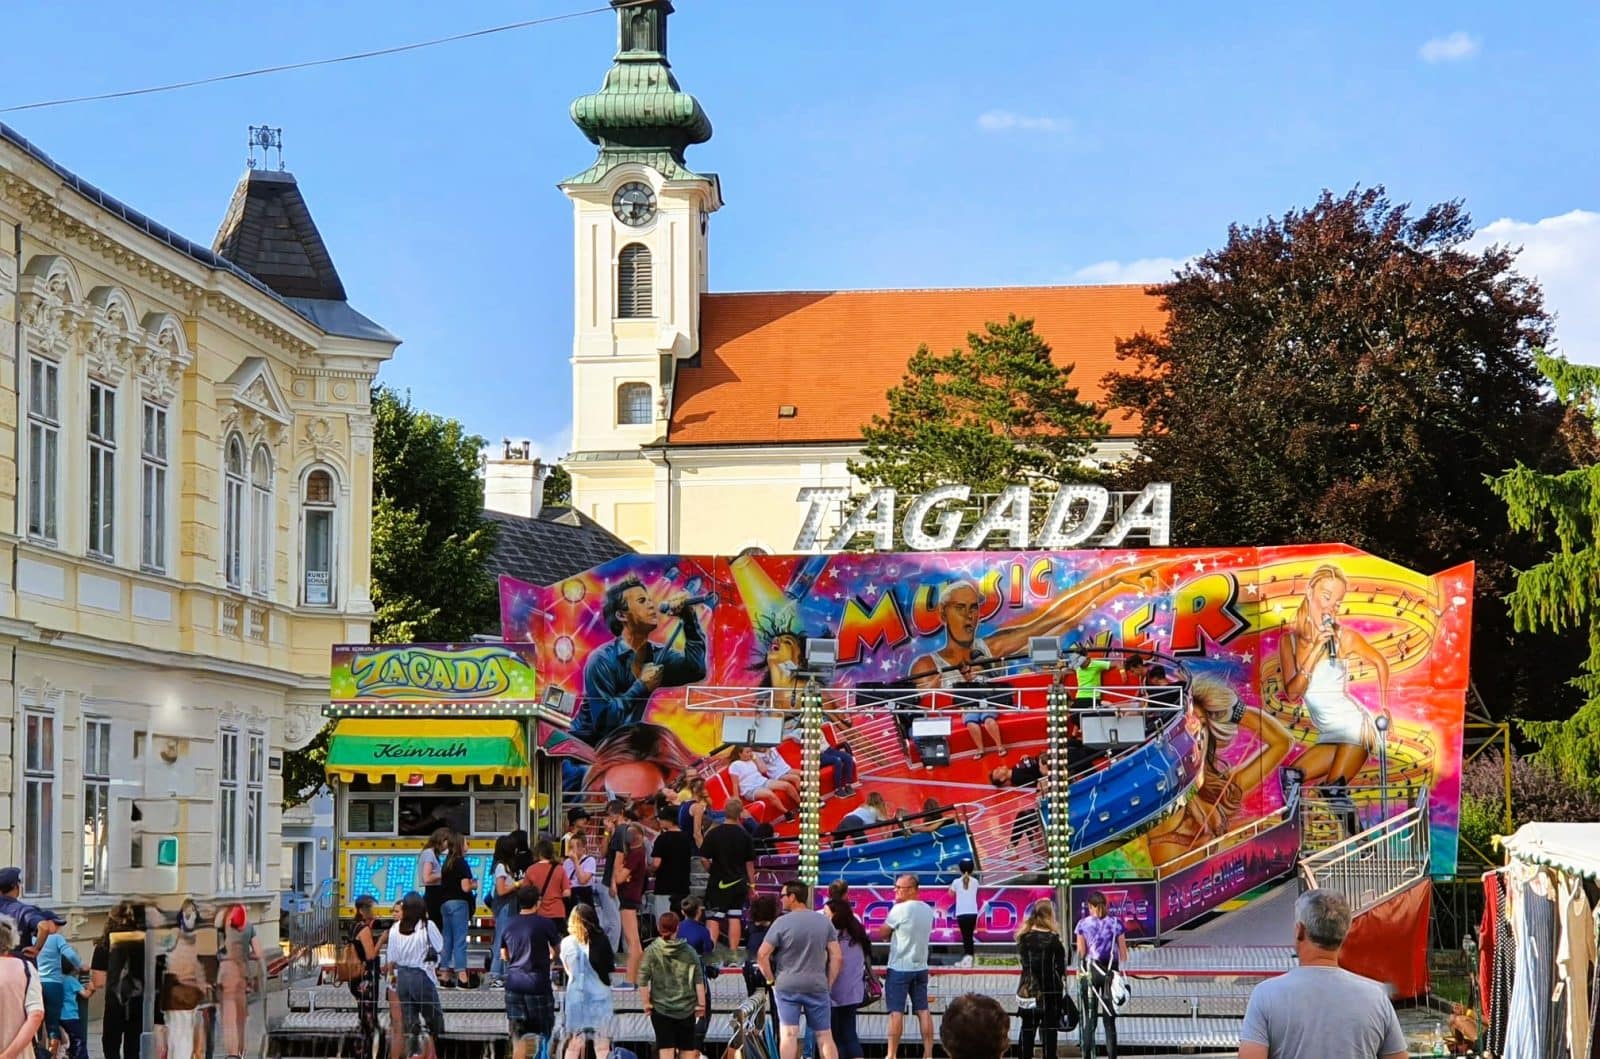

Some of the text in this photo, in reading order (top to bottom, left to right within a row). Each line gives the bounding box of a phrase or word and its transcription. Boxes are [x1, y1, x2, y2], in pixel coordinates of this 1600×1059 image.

[793, 482, 1172, 550] TAGADA
[351, 650, 510, 692] TAGADA
[373, 743, 468, 759] Keinrath
